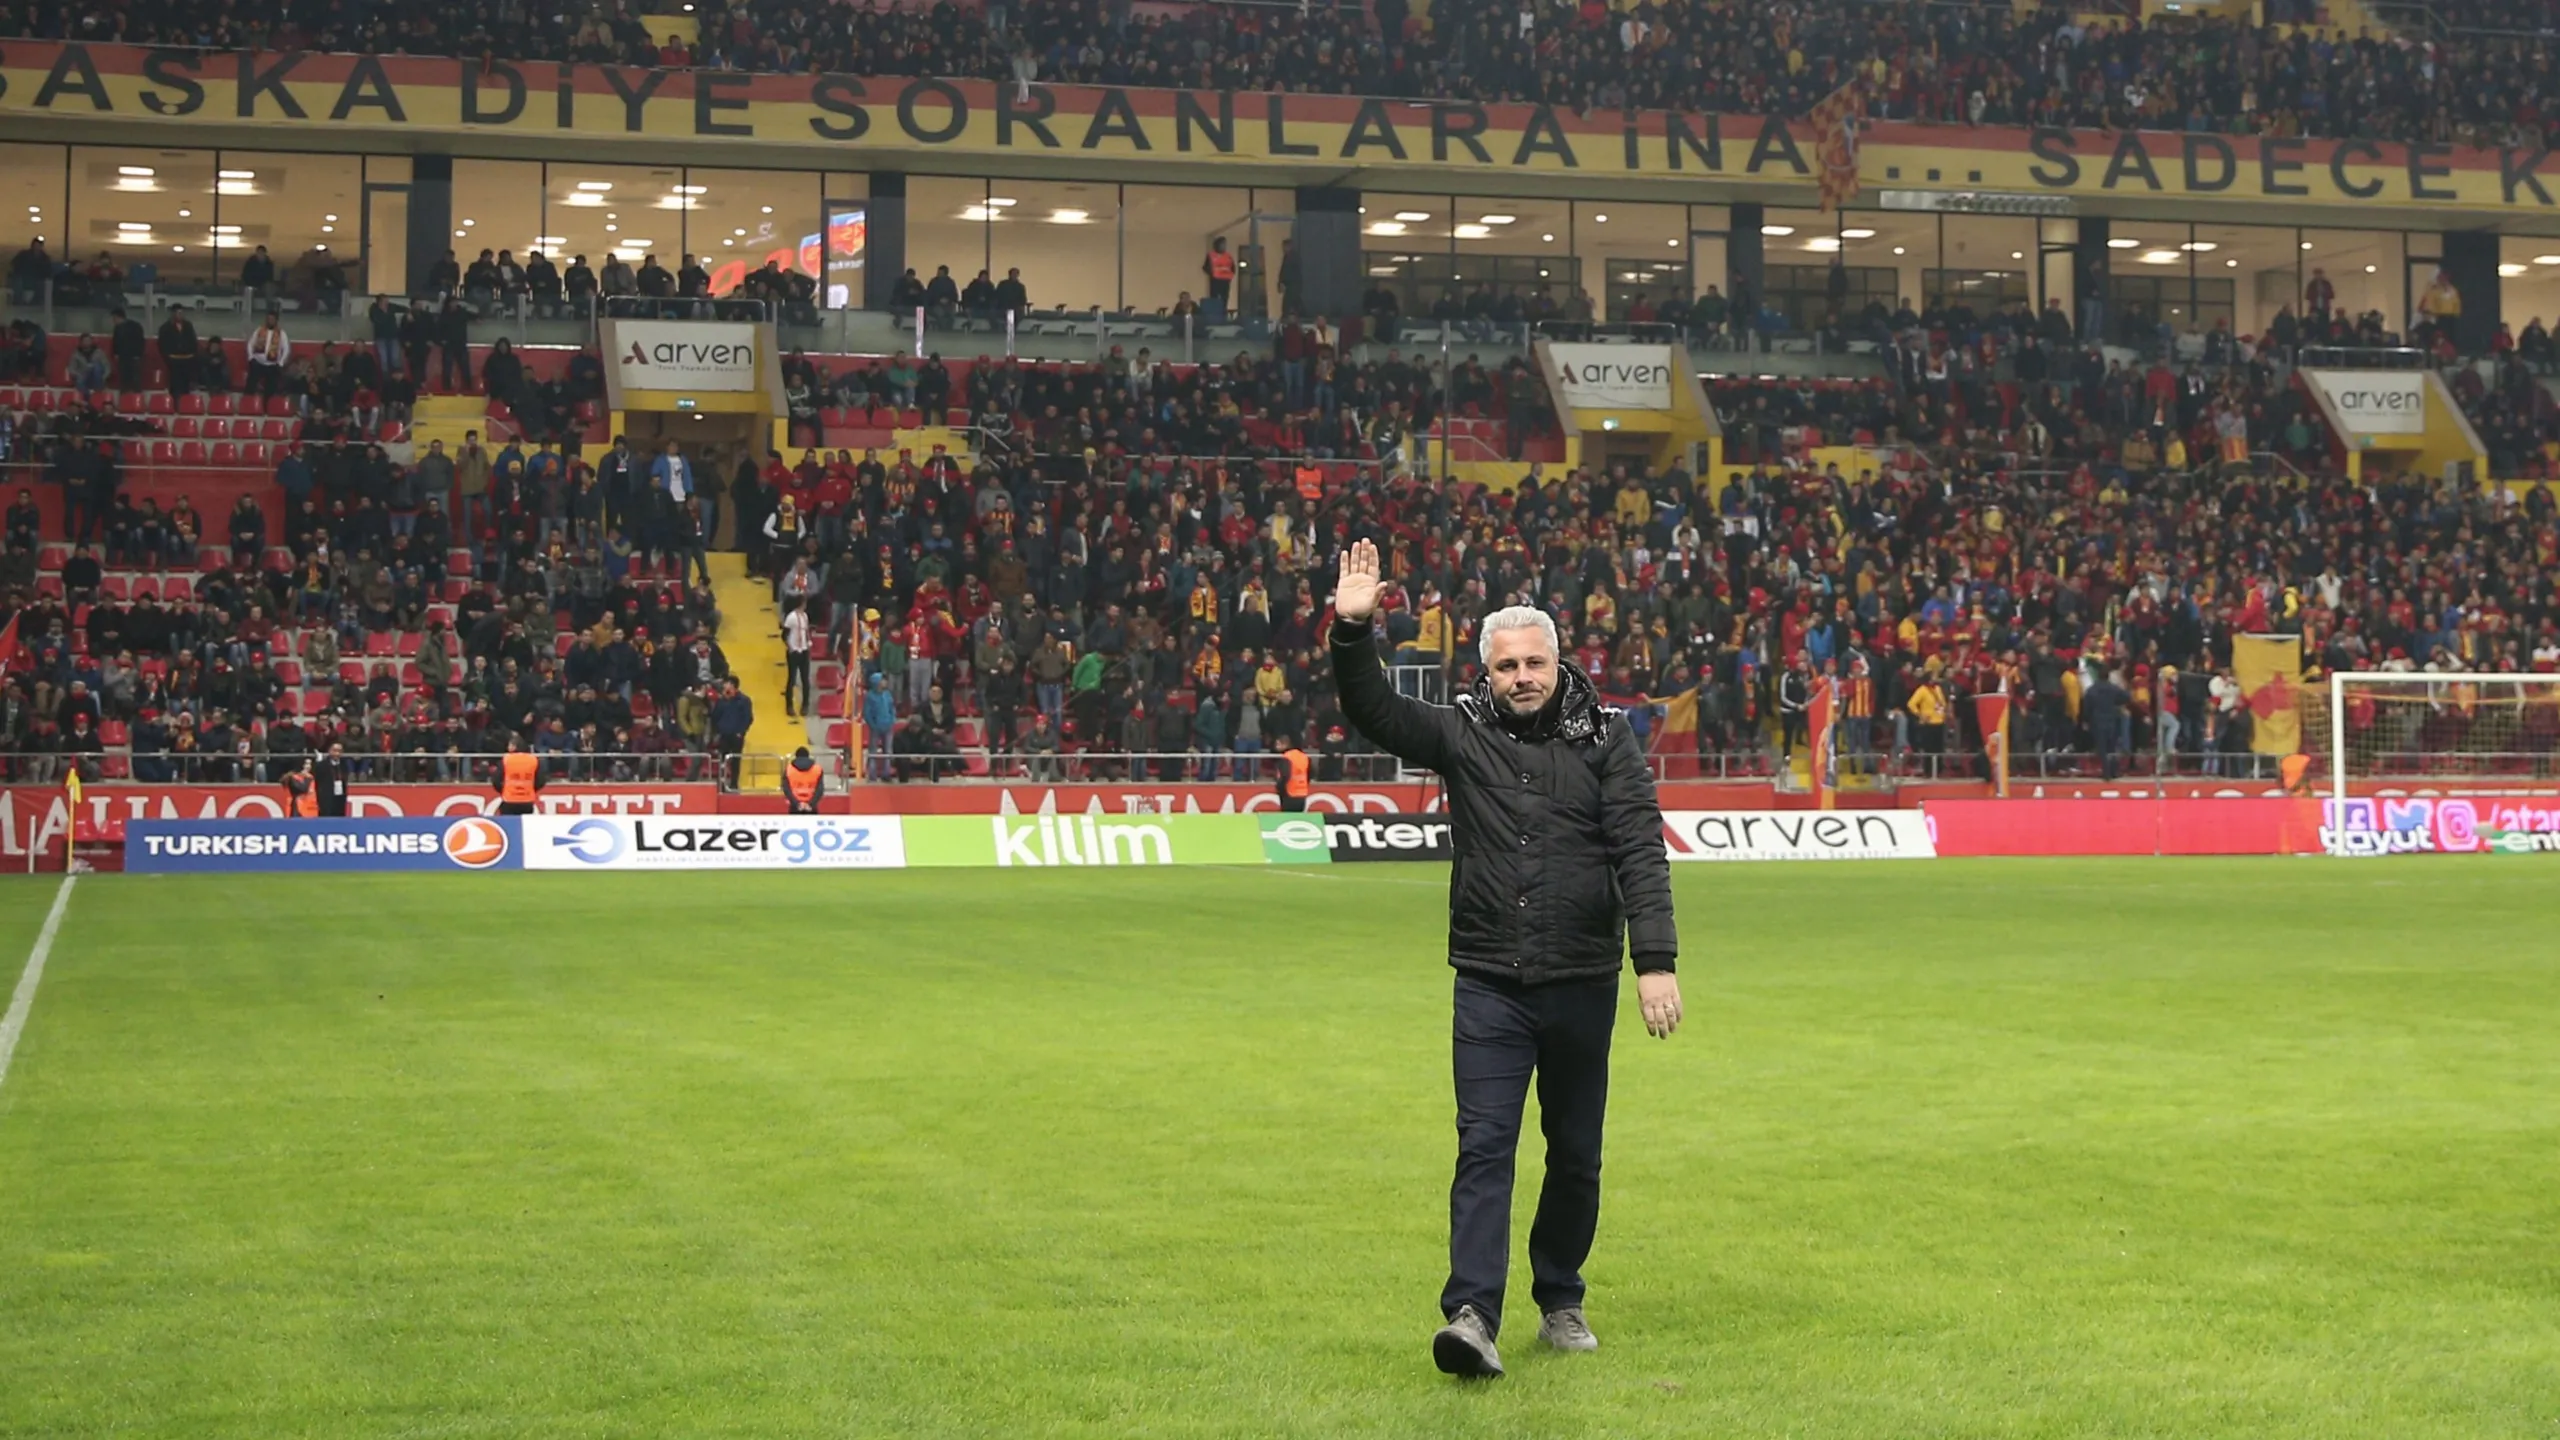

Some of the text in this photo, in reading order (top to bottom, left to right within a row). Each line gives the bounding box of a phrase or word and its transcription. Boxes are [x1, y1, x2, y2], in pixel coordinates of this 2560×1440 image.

[809, 74, 1580, 167] SORANLARA
[2028, 126, 2457, 199] SADECE
[653, 342, 753, 365] arven
[1582, 364, 1671, 383] arven
[2340, 390, 2421, 410] arven
[144, 832, 439, 856] TURKISH AIRLINES
[635, 820, 872, 863] Lazergöz
[992, 816, 1173, 866] kilim
[1696, 816, 1898, 848] arven
